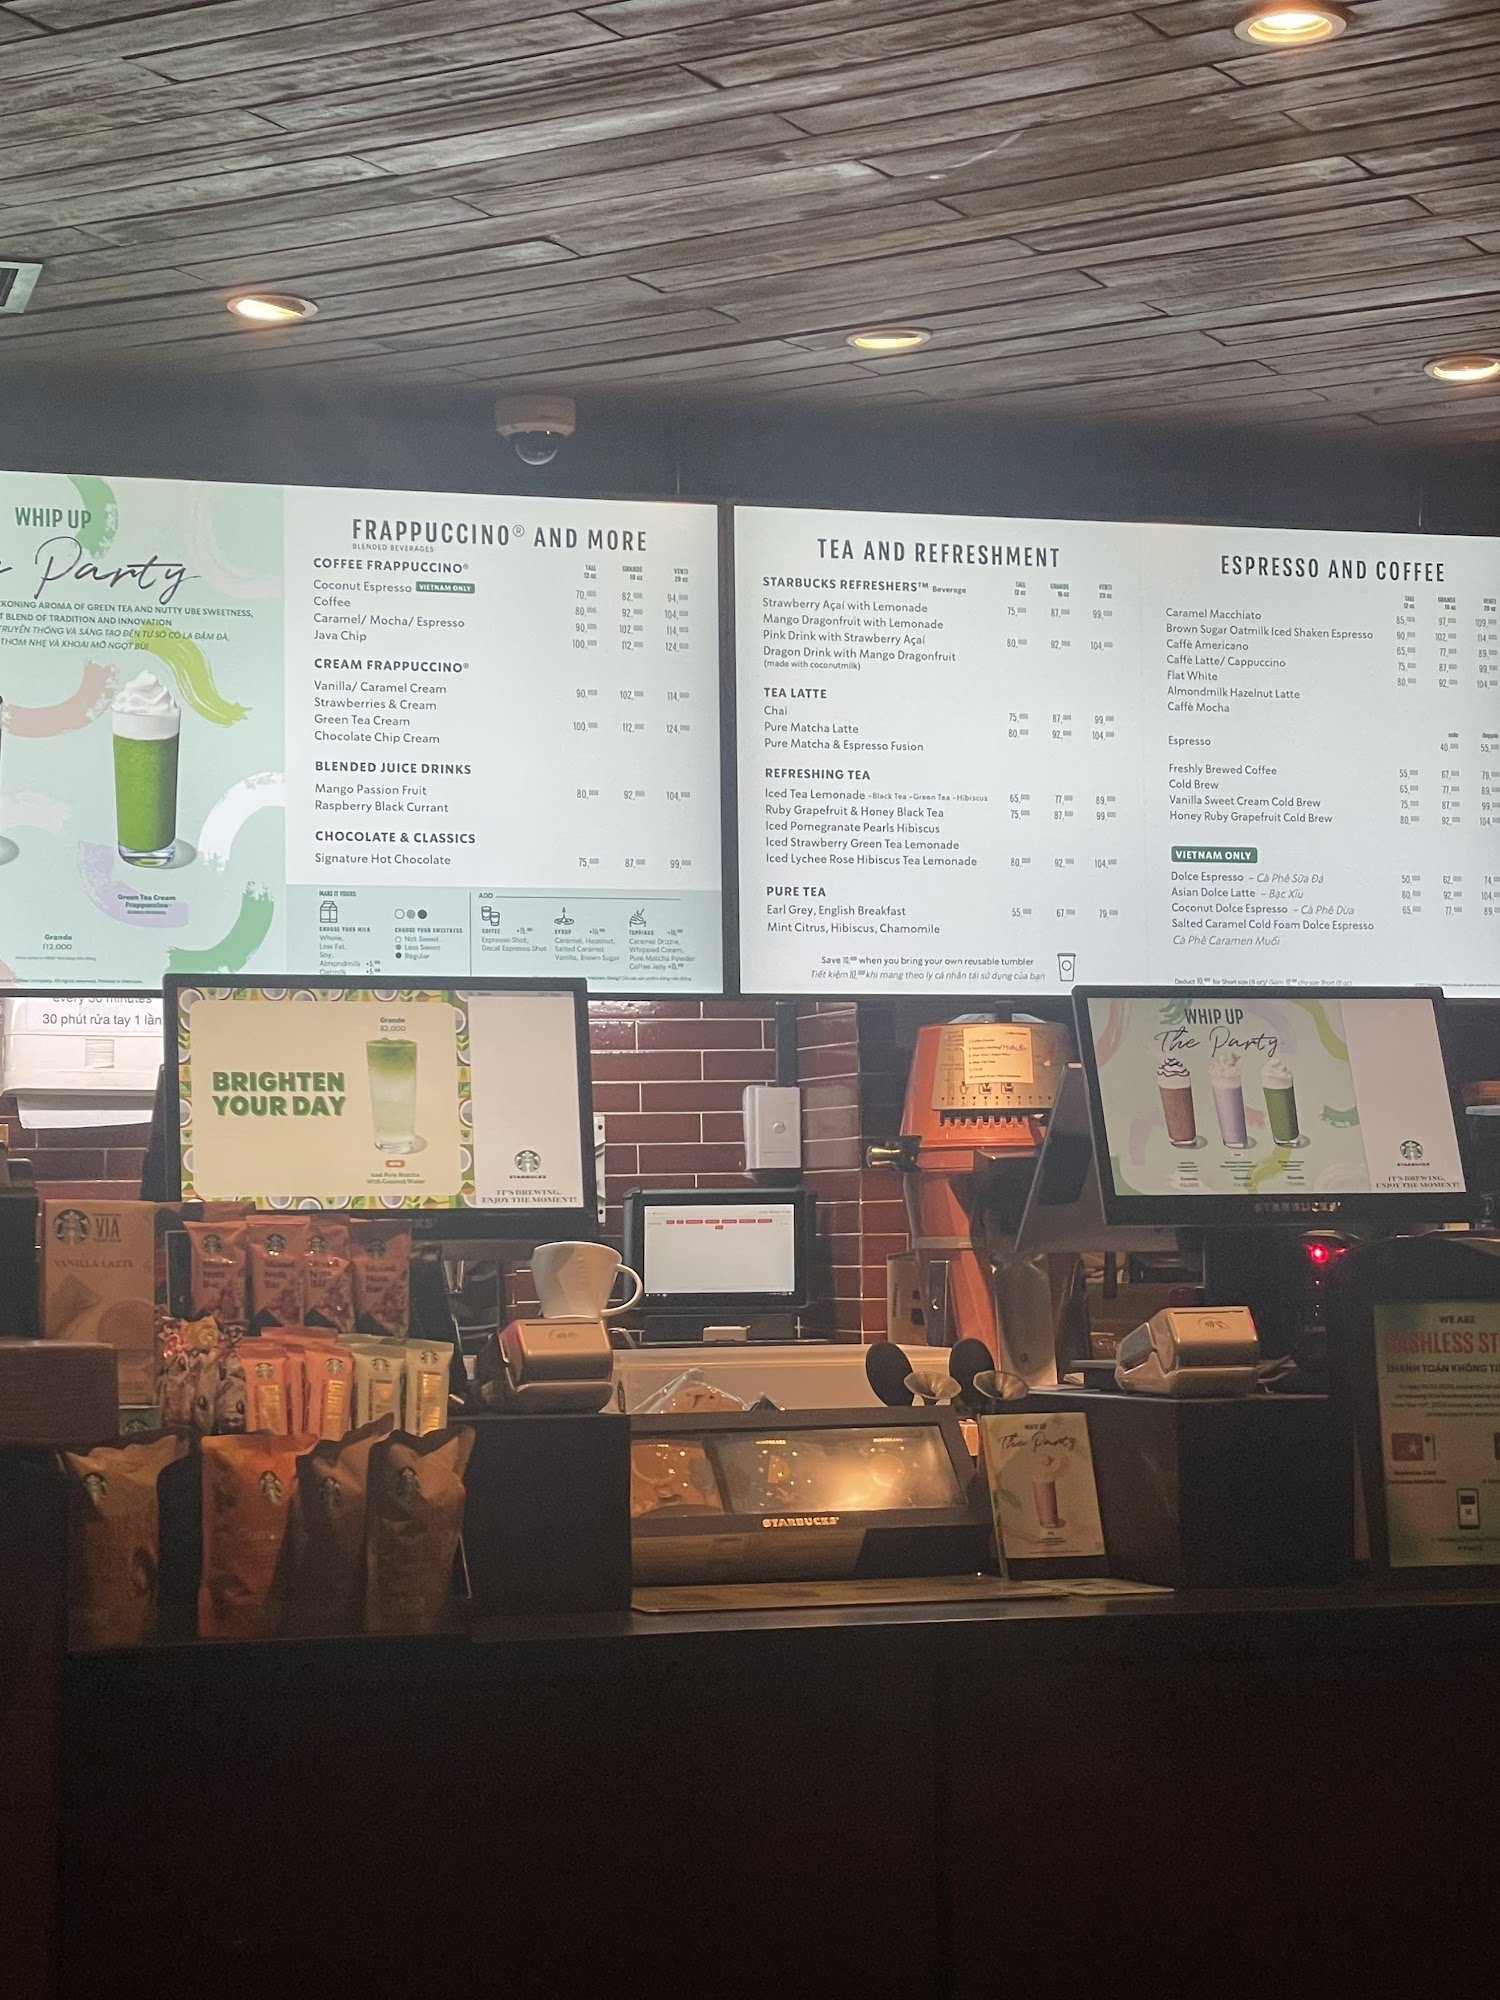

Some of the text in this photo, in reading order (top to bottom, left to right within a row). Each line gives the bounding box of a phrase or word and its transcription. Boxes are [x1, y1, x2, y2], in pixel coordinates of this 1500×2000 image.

[14, 507, 92, 529] WHIP UP
[534, 527, 577, 548] AND
[588, 529, 646, 551] MORE
[352, 543, 434, 553] BLENDED BEVERAGES
[817, 538, 1059, 568] TEA AND REFRESHMENT
[34, 536, 201, 605] Party
[313, 558, 363, 570] COFFEE
[1221, 555, 1444, 582] ESPRESSO AND COFFEE
[313, 579, 472, 594] Coconut Espresso VIETNAM ONLY
[763, 576, 836, 589] STARBUCKS
[932, 585, 966, 595] Beverage
[313, 596, 351, 607] Coffee
[762, 597, 820, 611] Strawberry
[847, 600, 870, 611] with
[873, 601, 928, 613] Lemonade
[0, 600, 37, 609] KONING
[38, 602, 72, 610] AROMA
[86, 603, 115, 612] GREEN
[117, 604, 133, 612] TEA
[134, 605, 153, 614] AND
[154, 606, 183, 614] NUTTY
[184, 607, 201, 616] UBE
[202, 608, 254, 618] SWEETNESS,
[1165, 607, 1262, 620] Caramel Macchiato
[6, 612, 172, 627] BLEND OF TRADITION AND INNOVATION
[313, 612, 465, 629] Caramel/ Mocha/ Espresso
[314, 629, 367, 643] Java Chip
[1166, 638, 1249, 651] Caffè Americano
[314, 658, 362, 670] CREAM
[764, 659, 861, 671] (made with coconutmilk)
[1167, 670, 1218, 681] Flat White
[764, 687, 827, 699] TEA LATTE
[314, 696, 436, 710] Strawberries & Cream
[1167, 701, 1230, 712] Caffè Mocha
[764, 705, 788, 716] Chai
[764, 721, 859, 734] Pure Matcha Latte
[1168, 735, 1211, 747] Espresso
[315, 761, 471, 775] BLENDED JUICE DRINKS
[765, 768, 870, 780] REFRESHING TEA
[1169, 763, 1277, 776] Freshly Brewed Coffee
[1168, 778, 1219, 790] Cold Brew
[765, 788, 787, 798] Iced
[790, 788, 808, 799] Tea
[810, 789, 866, 800] Lemonade
[315, 830, 476, 844] CHOCOLATE & CLASSICS
[315, 852, 451, 866] Signature Hot Chocolate
[1176, 850, 1252, 860] VIETNAM ONLY
[1171, 871, 1199, 881] Dolce
[1201, 871, 1244, 884] Espresso
[1256, 872, 1270, 883] Cà
[1271, 873, 1290, 883] Phê
[766, 886, 826, 897] PURE TEA
[767, 904, 906, 918] Earl Grey, English Breakfast
[1172, 935, 1186, 945] Cà
[1188, 935, 1207, 946] Phê
[1208, 935, 1253, 946] Caramen
[42, 1012, 162, 1028] 30 phút rửa tay 1 lần
[1184, 1008, 1244, 1024] WHIP UP
[1154, 1025, 1278, 1058] The Party
[212, 1071, 345, 1092] BRIGHTEN
[212, 1095, 346, 1116] YOUR DAY
[95, 1217, 119, 1238] VIA
[1439, 1315, 1455, 1324] WE
[1383, 1331, 1474, 1354] SHLESS
[762, 1516, 839, 1528] STARBUCKS
